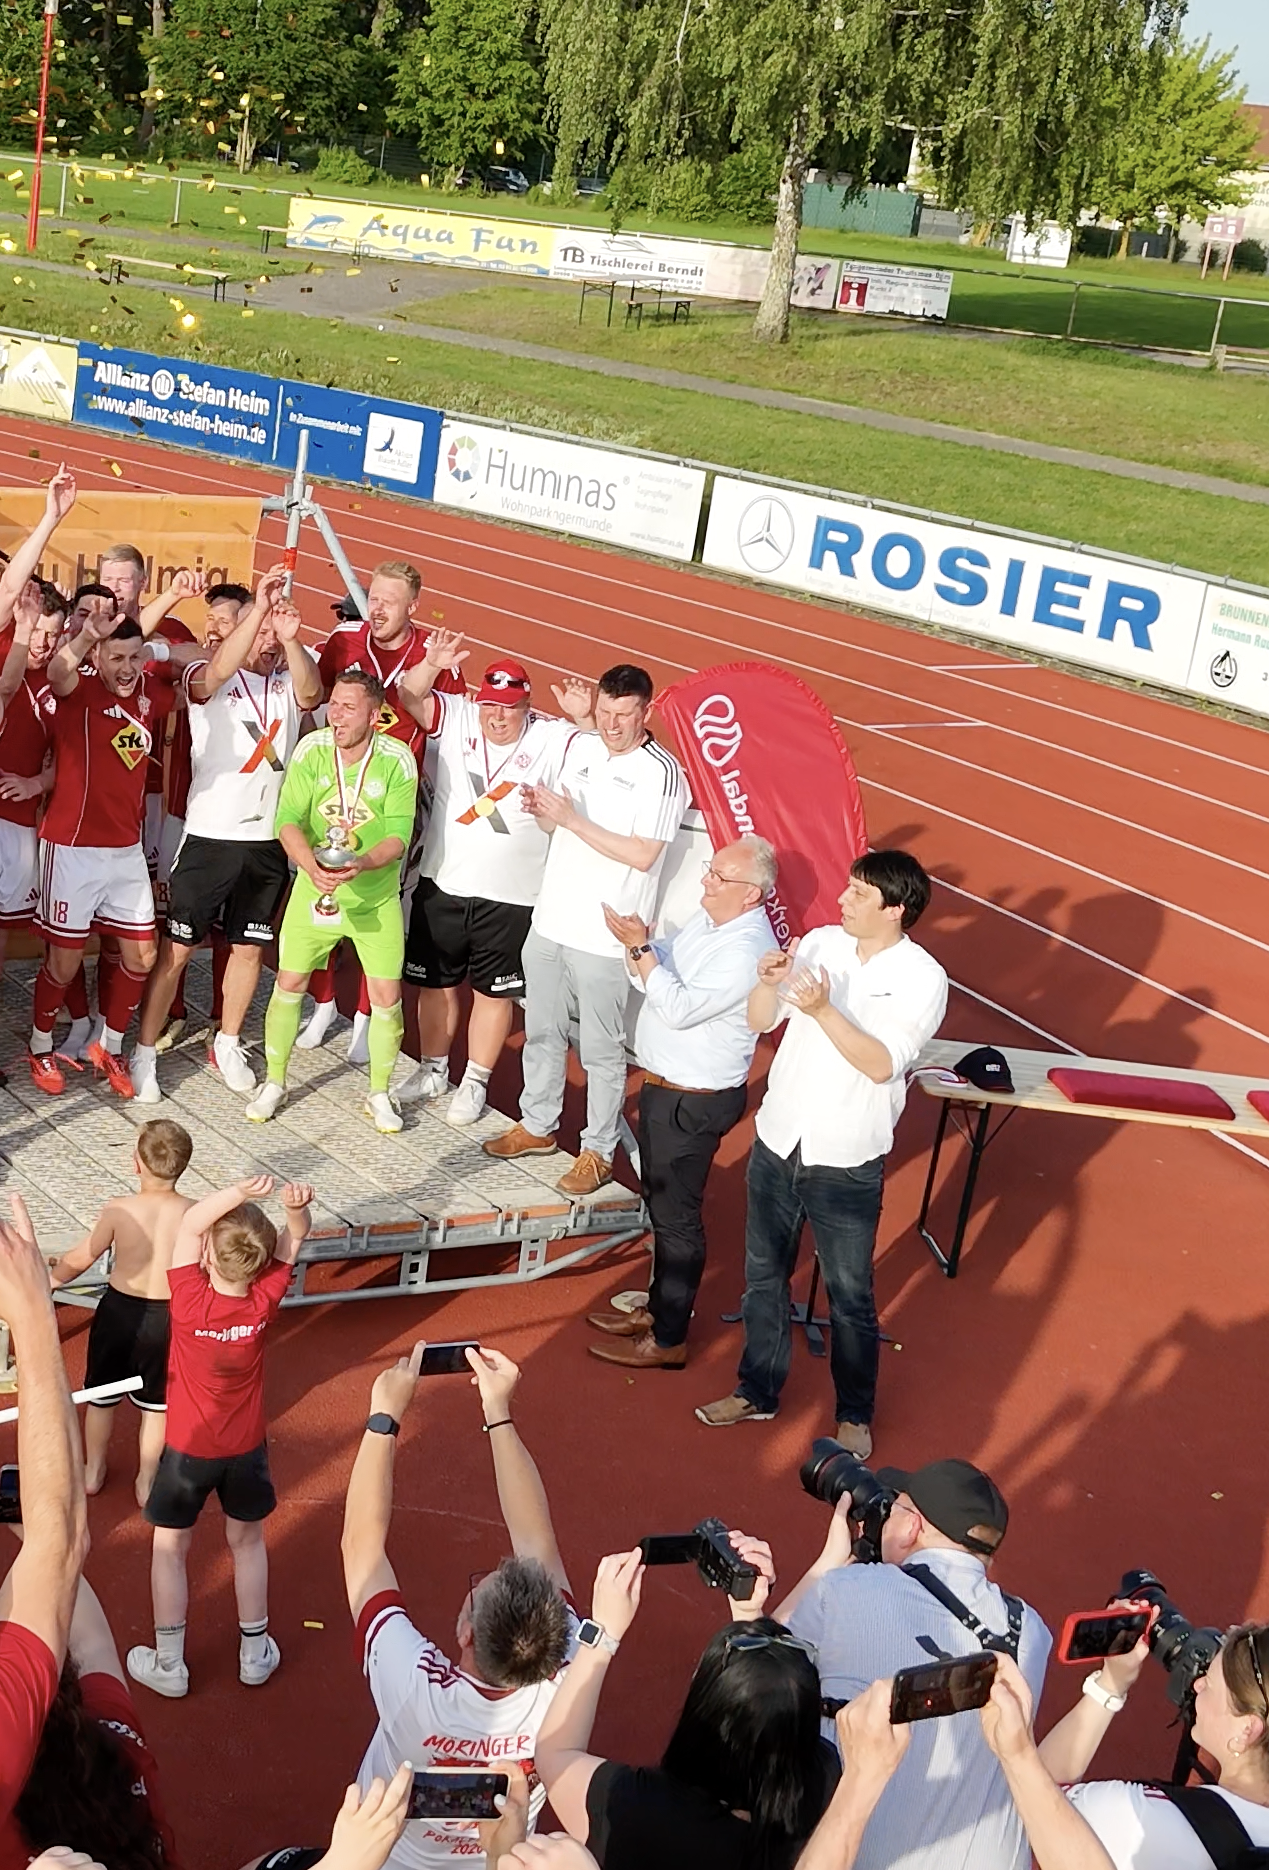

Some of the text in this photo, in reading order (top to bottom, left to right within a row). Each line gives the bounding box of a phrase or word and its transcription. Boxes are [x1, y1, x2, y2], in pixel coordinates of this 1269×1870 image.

[360, 215, 539, 255] Aqua Fun
[560, 246, 584, 263] TB
[590, 255, 653, 272] Tischlerei
[658, 262, 704, 277] Berndt
[94, 361, 271, 416] Allianz Stefan Heim
[89, 395, 267, 445] www.allianz-stefan-heim.de
[485, 447, 618, 512] Huminas
[808, 515, 1162, 652] ROSIER
[1212, 622, 1252, 645] Hermann
[118, 732, 145, 748] SK
[54, 900, 69, 924] 18
[423, 1734, 531, 1758] MÖRINGER
